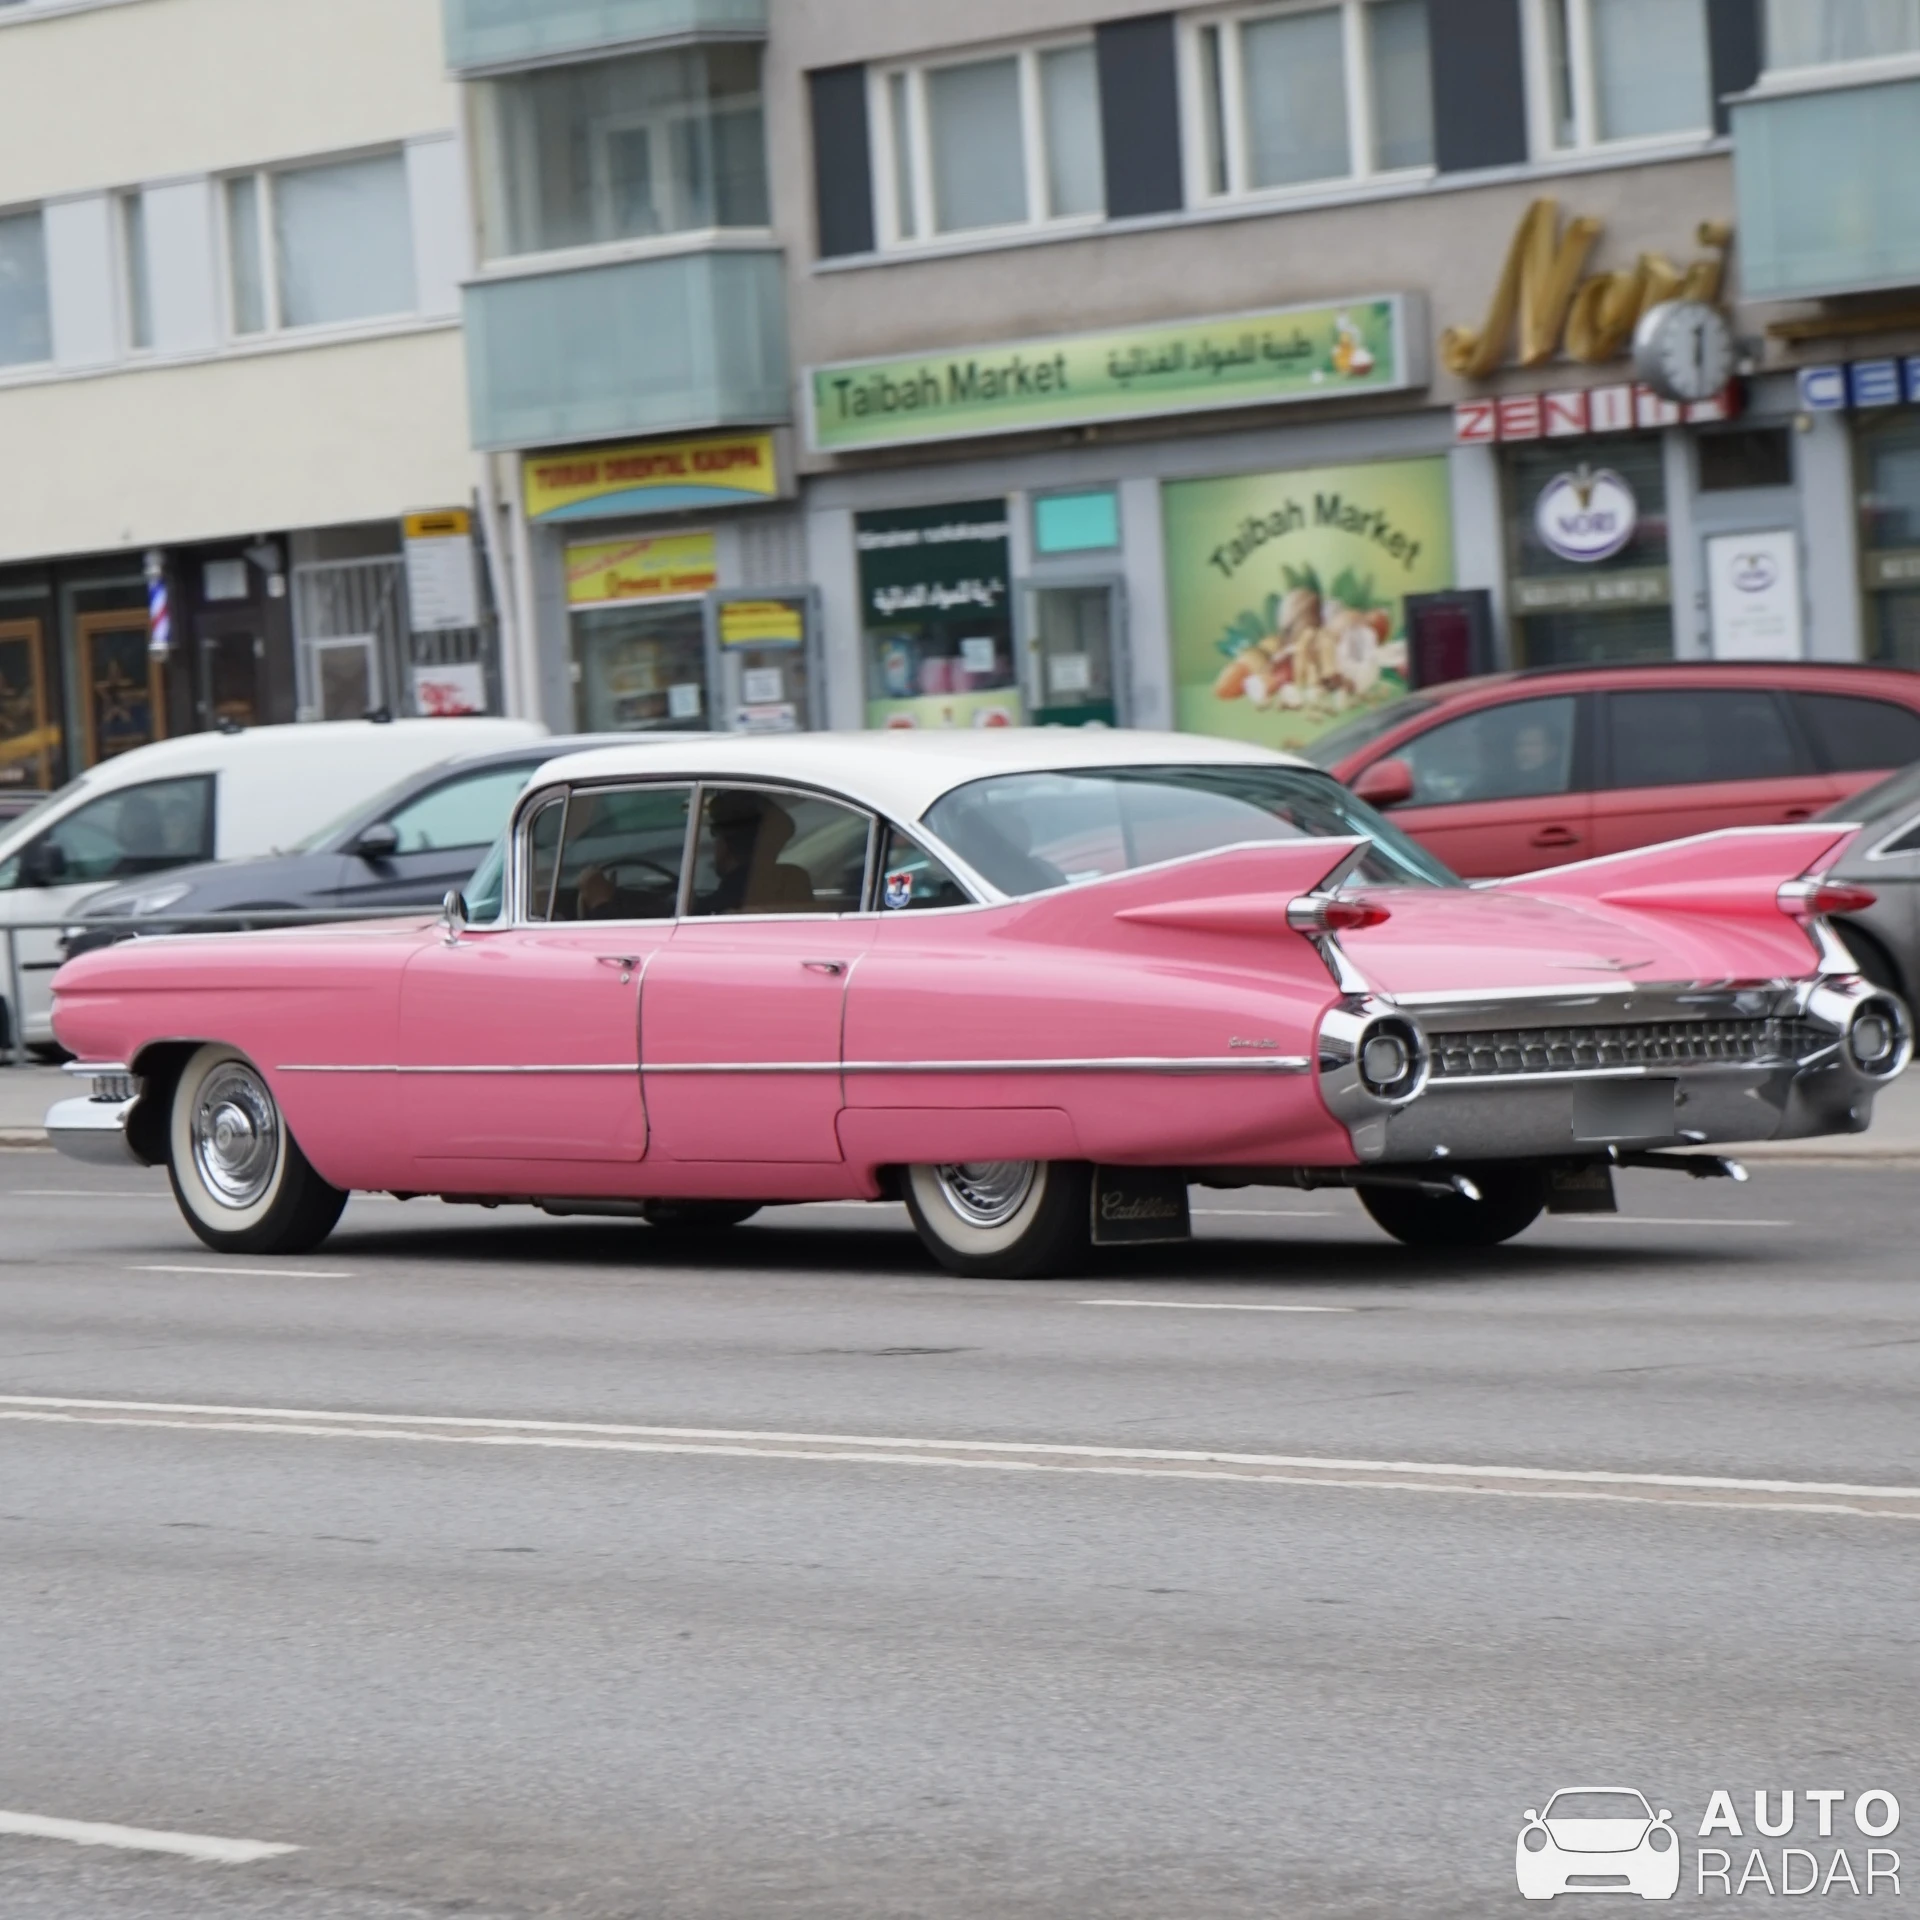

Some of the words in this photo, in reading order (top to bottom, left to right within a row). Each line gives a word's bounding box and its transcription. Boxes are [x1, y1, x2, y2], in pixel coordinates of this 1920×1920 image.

[833, 372, 941, 418] Taibah
[948, 354, 1067, 402] Market
[1456, 386, 1728, 440] ZENIT
[1208, 498, 1305, 579] Taibah
[1313, 493, 1421, 572] Market
[1101, 1190, 1179, 1220] Cadillac
